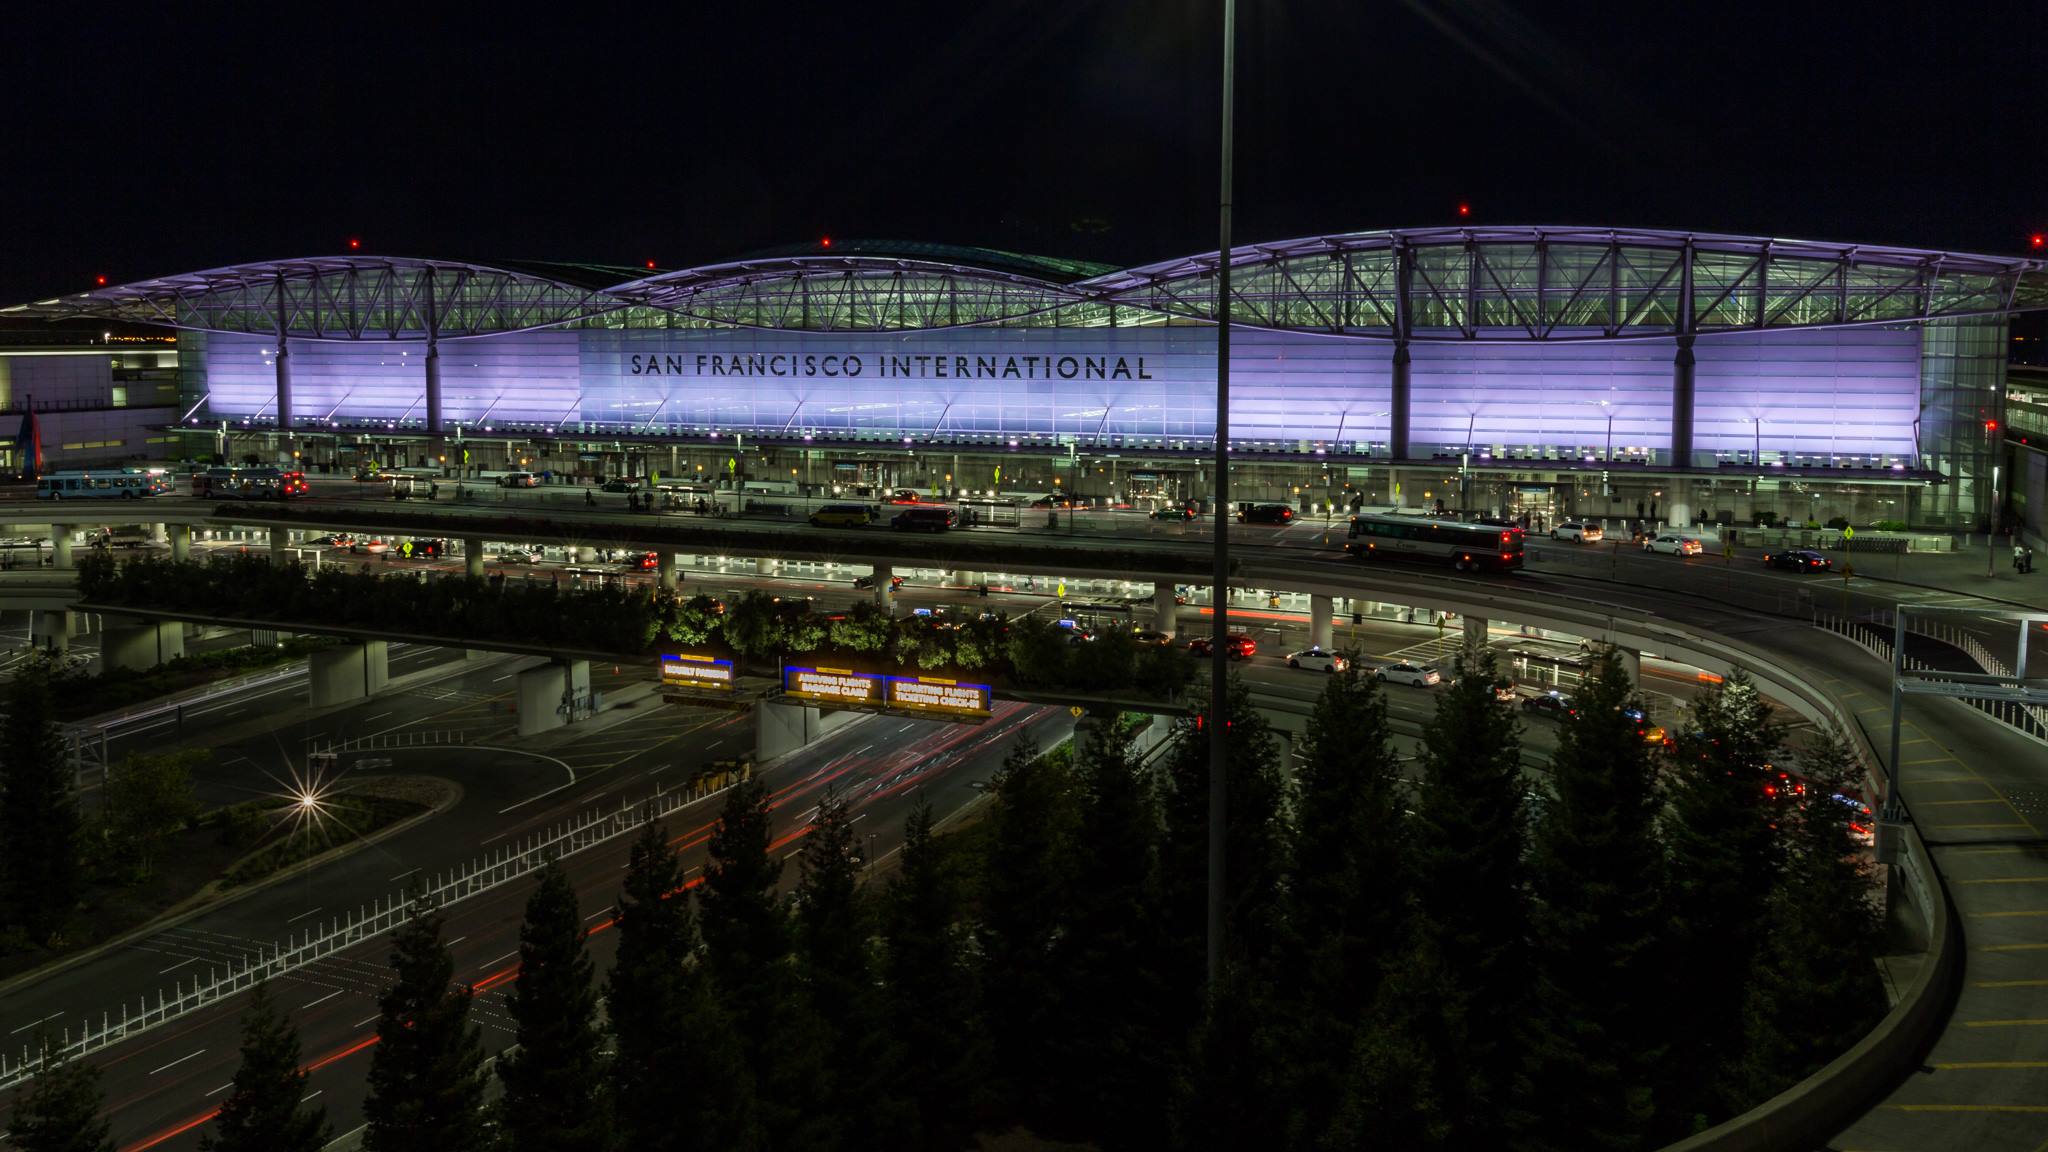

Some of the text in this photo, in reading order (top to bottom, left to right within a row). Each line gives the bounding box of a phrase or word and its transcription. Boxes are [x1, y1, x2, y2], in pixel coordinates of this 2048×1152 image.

[631, 354, 1152, 379] SAN FRANCISCO INTERNATIONAL
[799, 673, 872, 689] ARRIVING FLIGHTS
[801, 682, 868, 698] BAGGAGE CLAIM
[896, 682, 979, 699] DEPARTING FLIGHTS
[896, 691, 979, 709] TICKETING CHECK-IN
